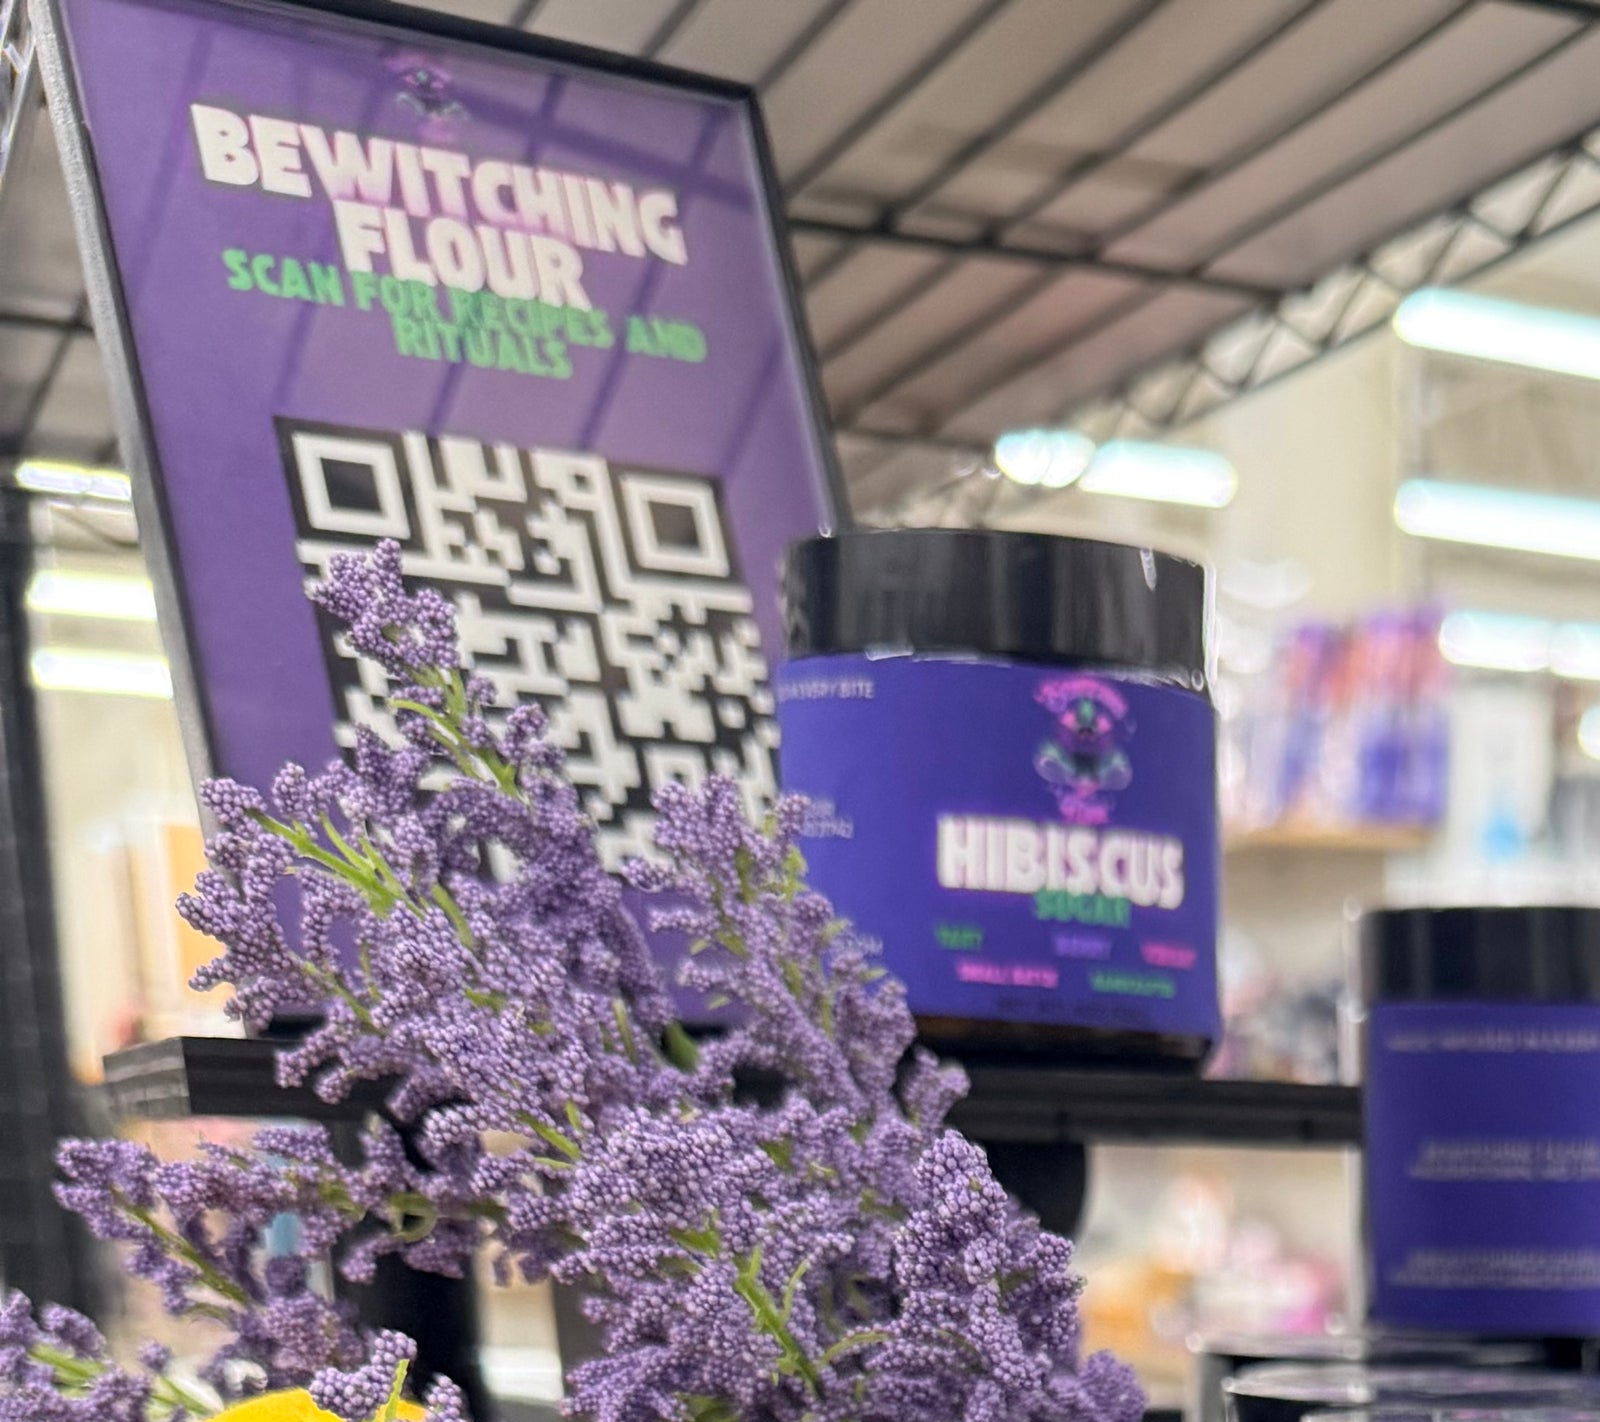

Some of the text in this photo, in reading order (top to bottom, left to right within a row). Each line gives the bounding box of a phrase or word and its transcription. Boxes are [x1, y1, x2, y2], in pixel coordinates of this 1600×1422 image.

[191, 103, 688, 266] BEWITCHING
[222, 248, 345, 308] SCAN
[332, 199, 592, 312] FLOUR
[936, 813, 1185, 910] HIBISCUS
